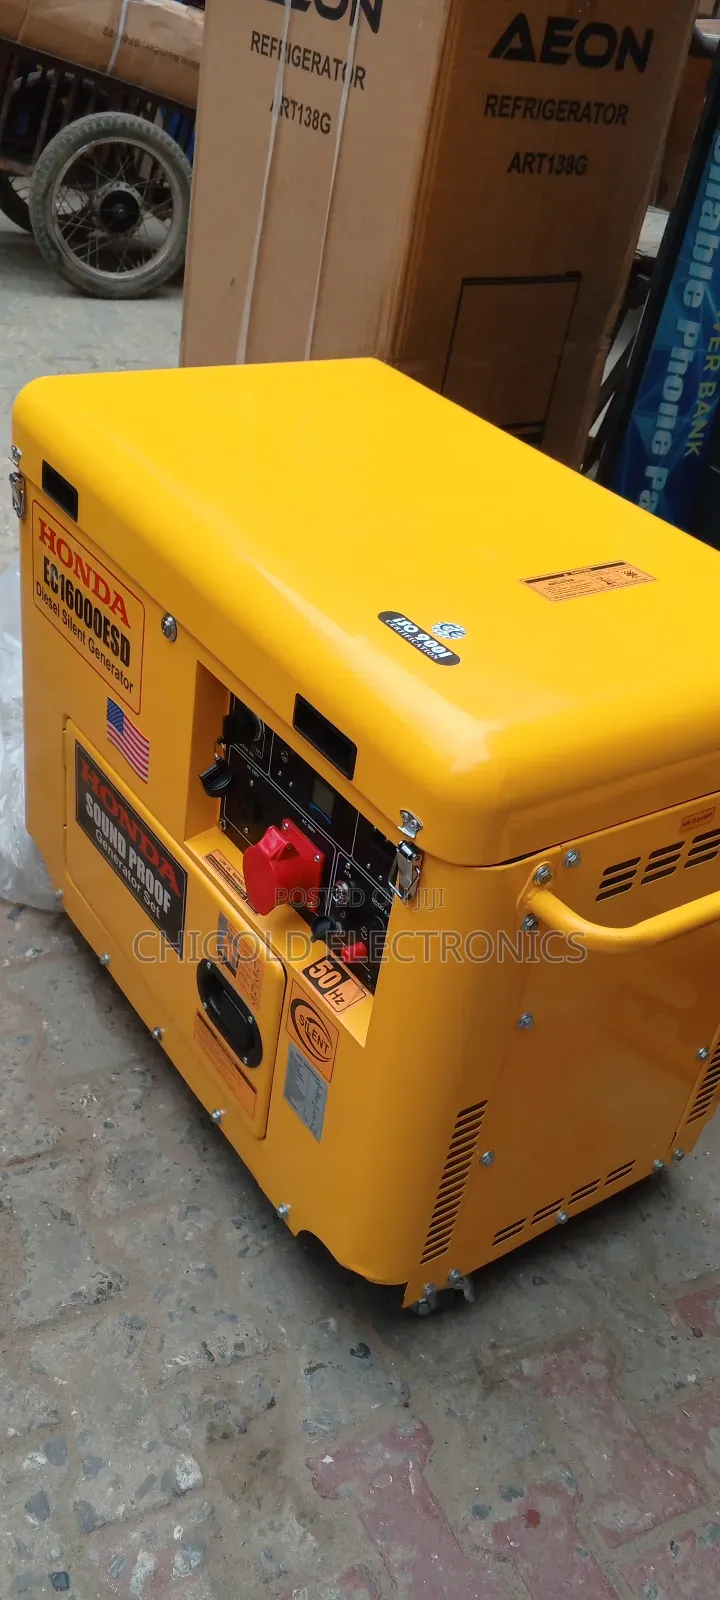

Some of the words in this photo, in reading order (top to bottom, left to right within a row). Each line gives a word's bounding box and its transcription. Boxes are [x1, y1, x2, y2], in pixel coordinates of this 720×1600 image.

[488, 12, 654, 73] AEON
[484, 94, 629, 126] REFRIGERATOR
[507, 152, 588, 175] ART138G
[652, 319, 702, 456] Phone
[683, 381, 716, 457] BANK
[38, 516, 131, 629] HONDA
[36, 581, 60, 618] Diesel
[62, 608, 86, 645] Silent
[88, 637, 134, 694] Generator
[43, 555, 131, 667] EC16000ESD
[385, 619, 440, 659] CERTIFICATION
[415, 633, 453, 658] 9001
[80, 760, 181, 897] HONDA
[85, 793, 126, 860] SOUND
[129, 846, 171, 914] PROOF
[681, 820, 691, 828] AIR
[690, 812, 713, 825] CLEANER
[95, 829, 141, 894] Generator
[143, 890, 160, 919] Set
[308, 960, 343, 989] 50
[328, 989, 346, 1006] Hz
[298, 1014, 331, 1054] SILENT
